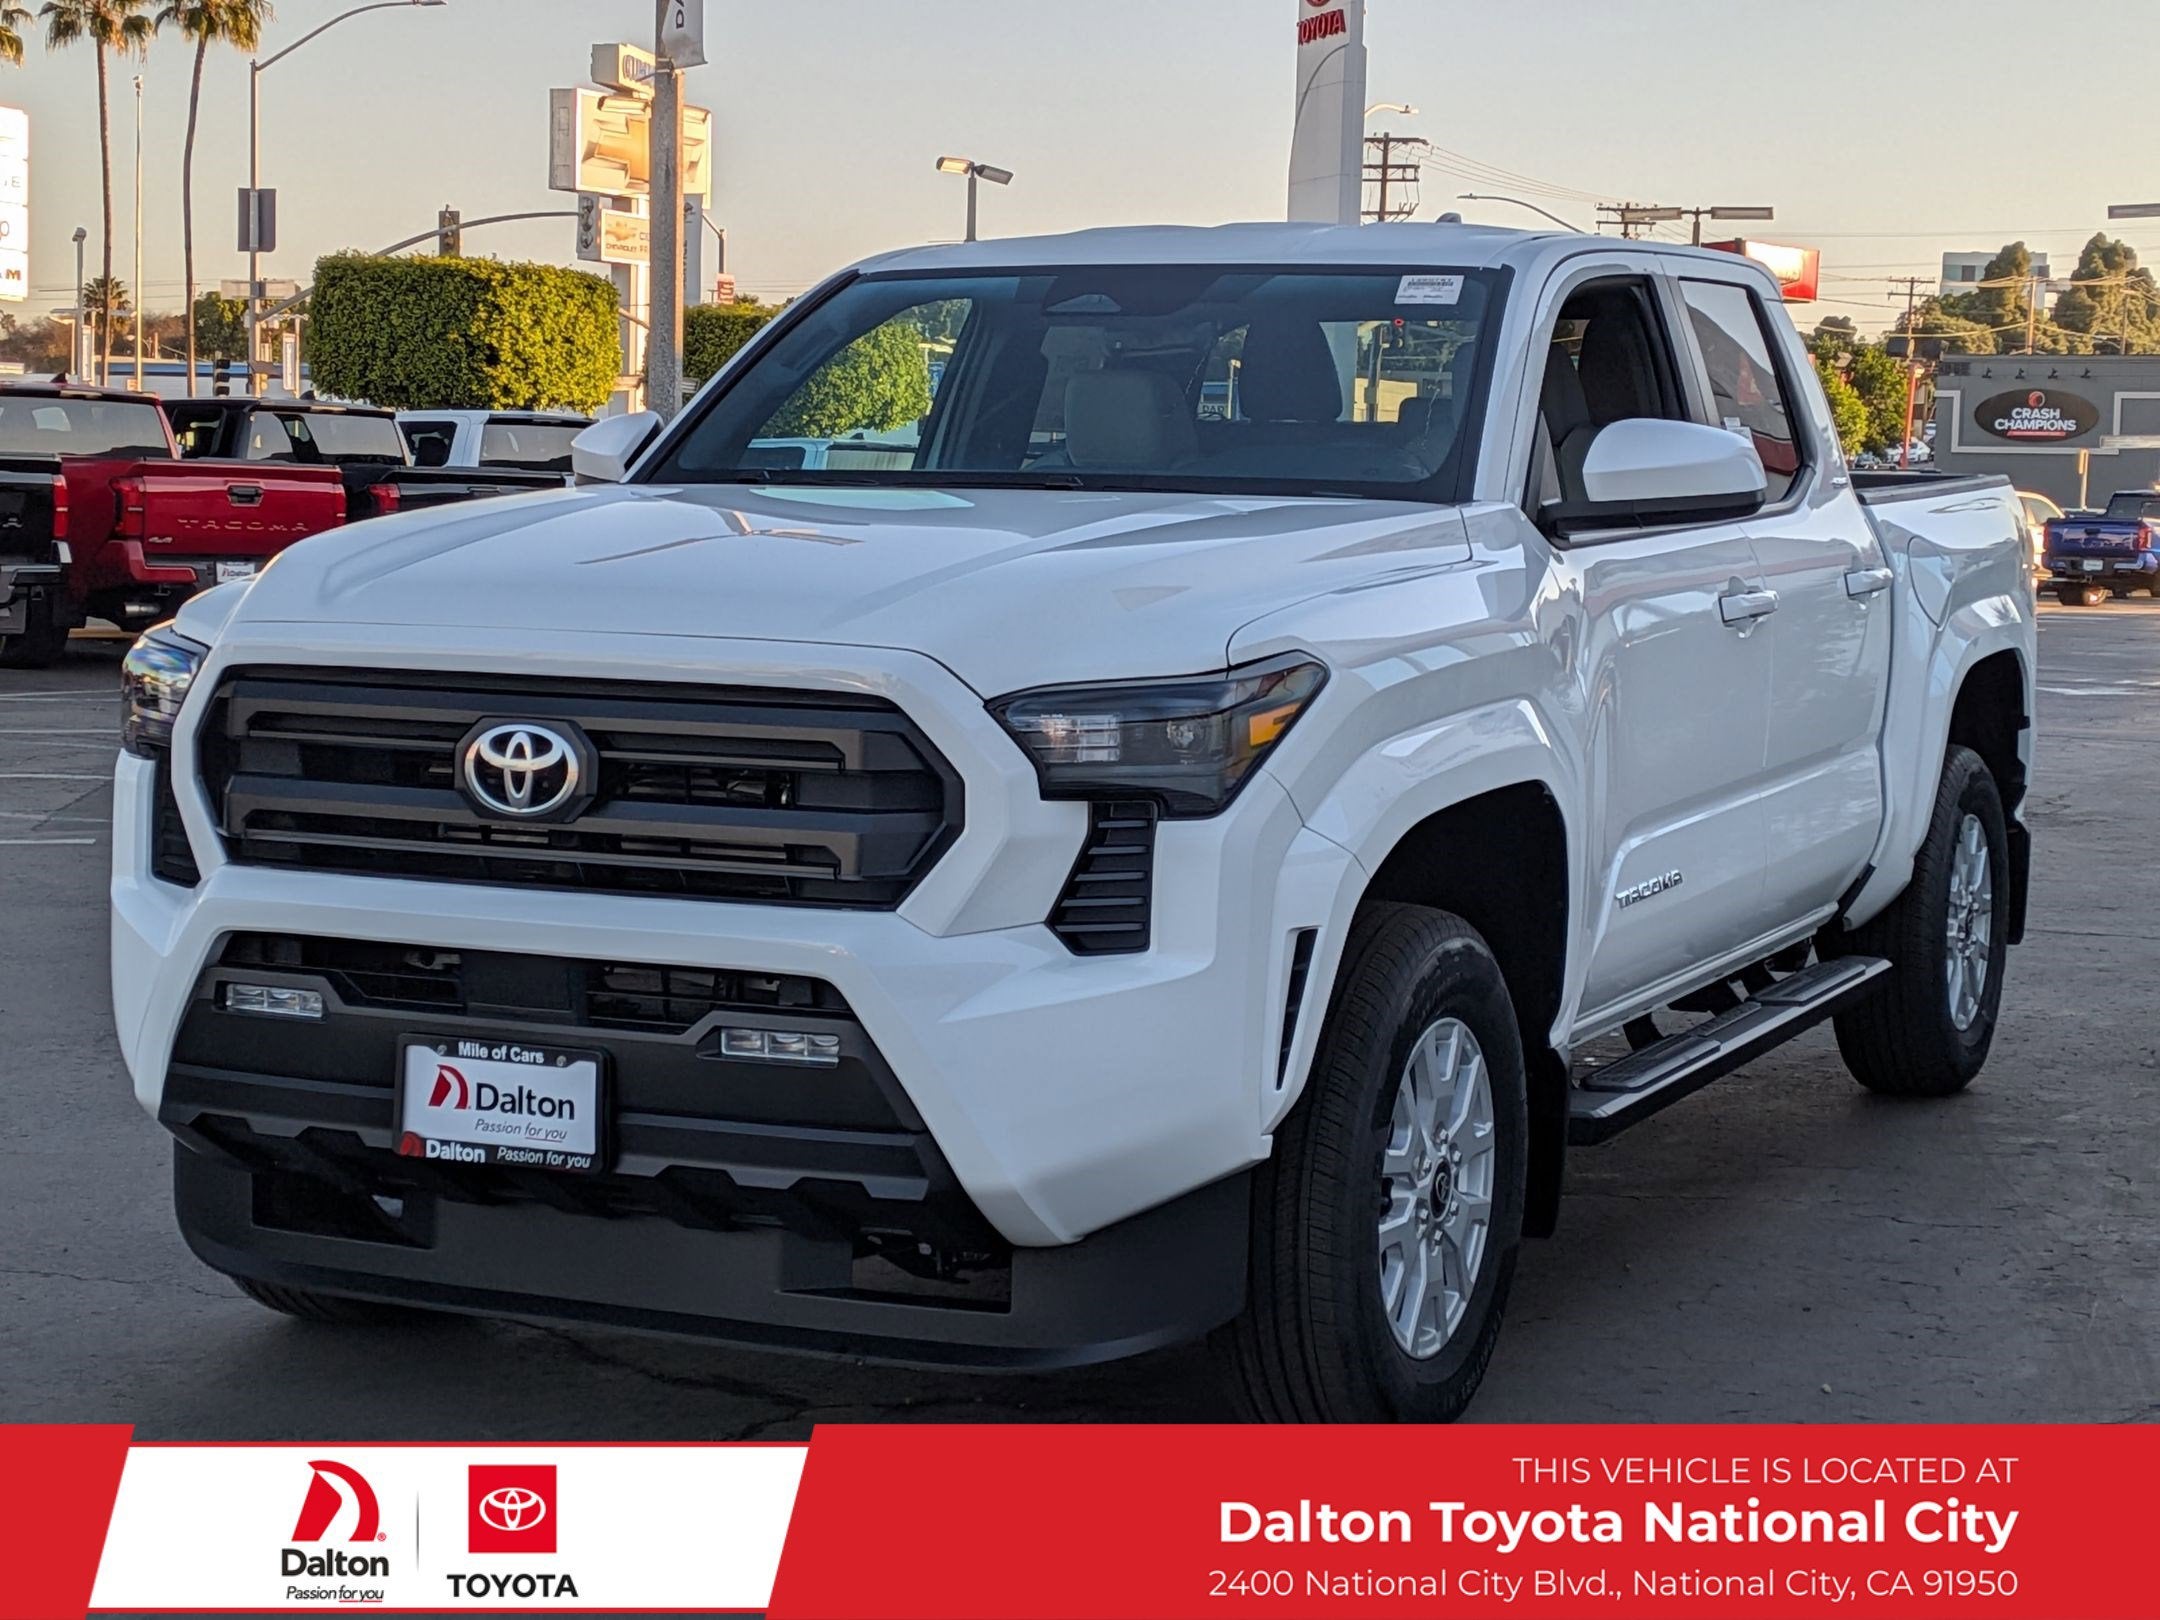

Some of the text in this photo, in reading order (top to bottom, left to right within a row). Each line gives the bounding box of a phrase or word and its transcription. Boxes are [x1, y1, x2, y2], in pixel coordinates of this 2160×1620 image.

[1297, 9, 1346, 45] TOYOTA
[1994, 418, 2077, 431] CHAMPIONS
[2011, 407, 2061, 419] CRASH
[177, 519, 309, 531] TACOMA
[1615, 869, 1683, 909] TACOMA
[458, 1041, 545, 1064] Mile of Cars
[475, 1082, 575, 1120] Dalton
[474, 1118, 568, 1141] Passion for you
[425, 1139, 591, 1169] Dalton Passion for you
